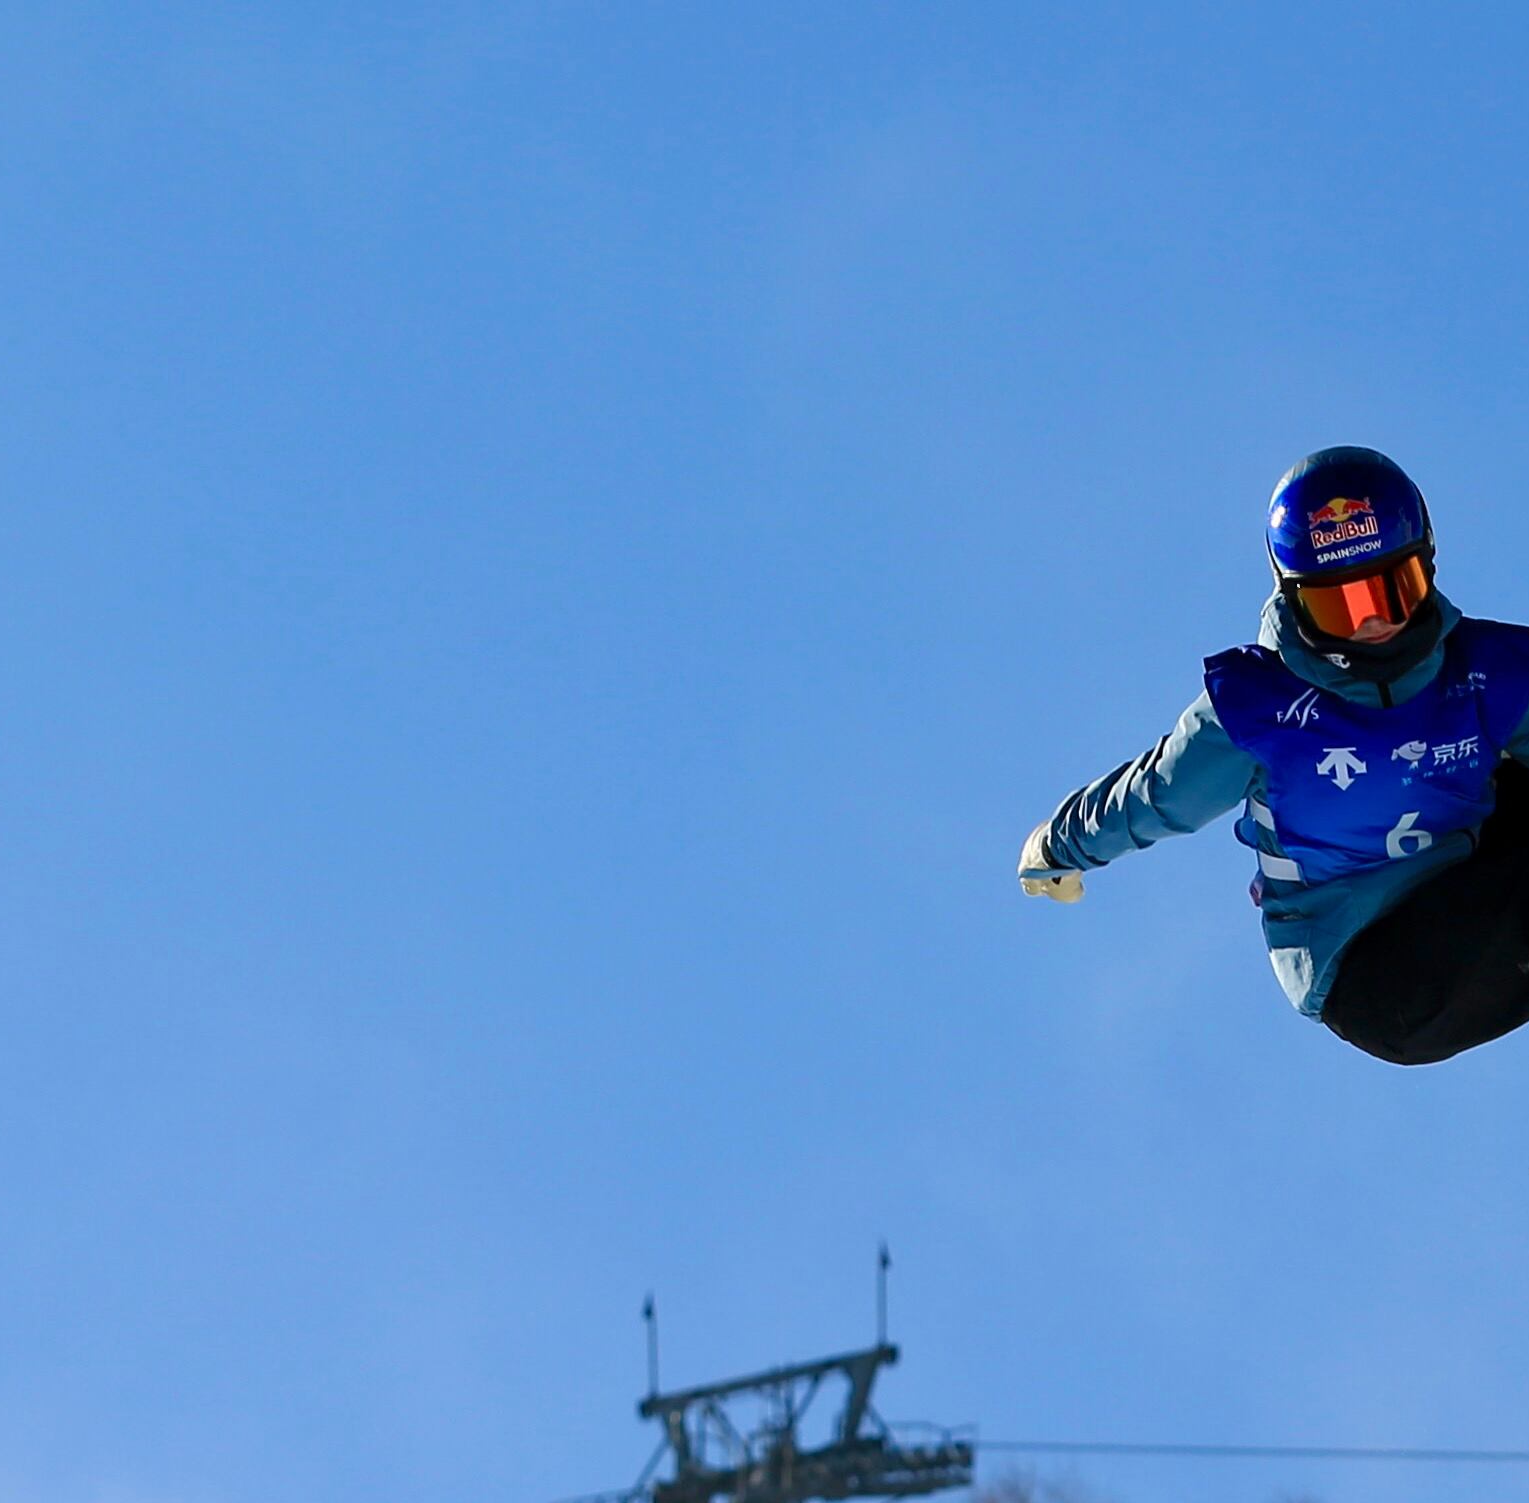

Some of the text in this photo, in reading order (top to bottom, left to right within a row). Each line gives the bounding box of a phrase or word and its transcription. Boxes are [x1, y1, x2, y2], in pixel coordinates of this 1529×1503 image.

[1317, 540, 1382, 564] SPAINSNOW
[1431, 735, 1479, 766] 京东
[1386, 811, 1433, 859] 6
